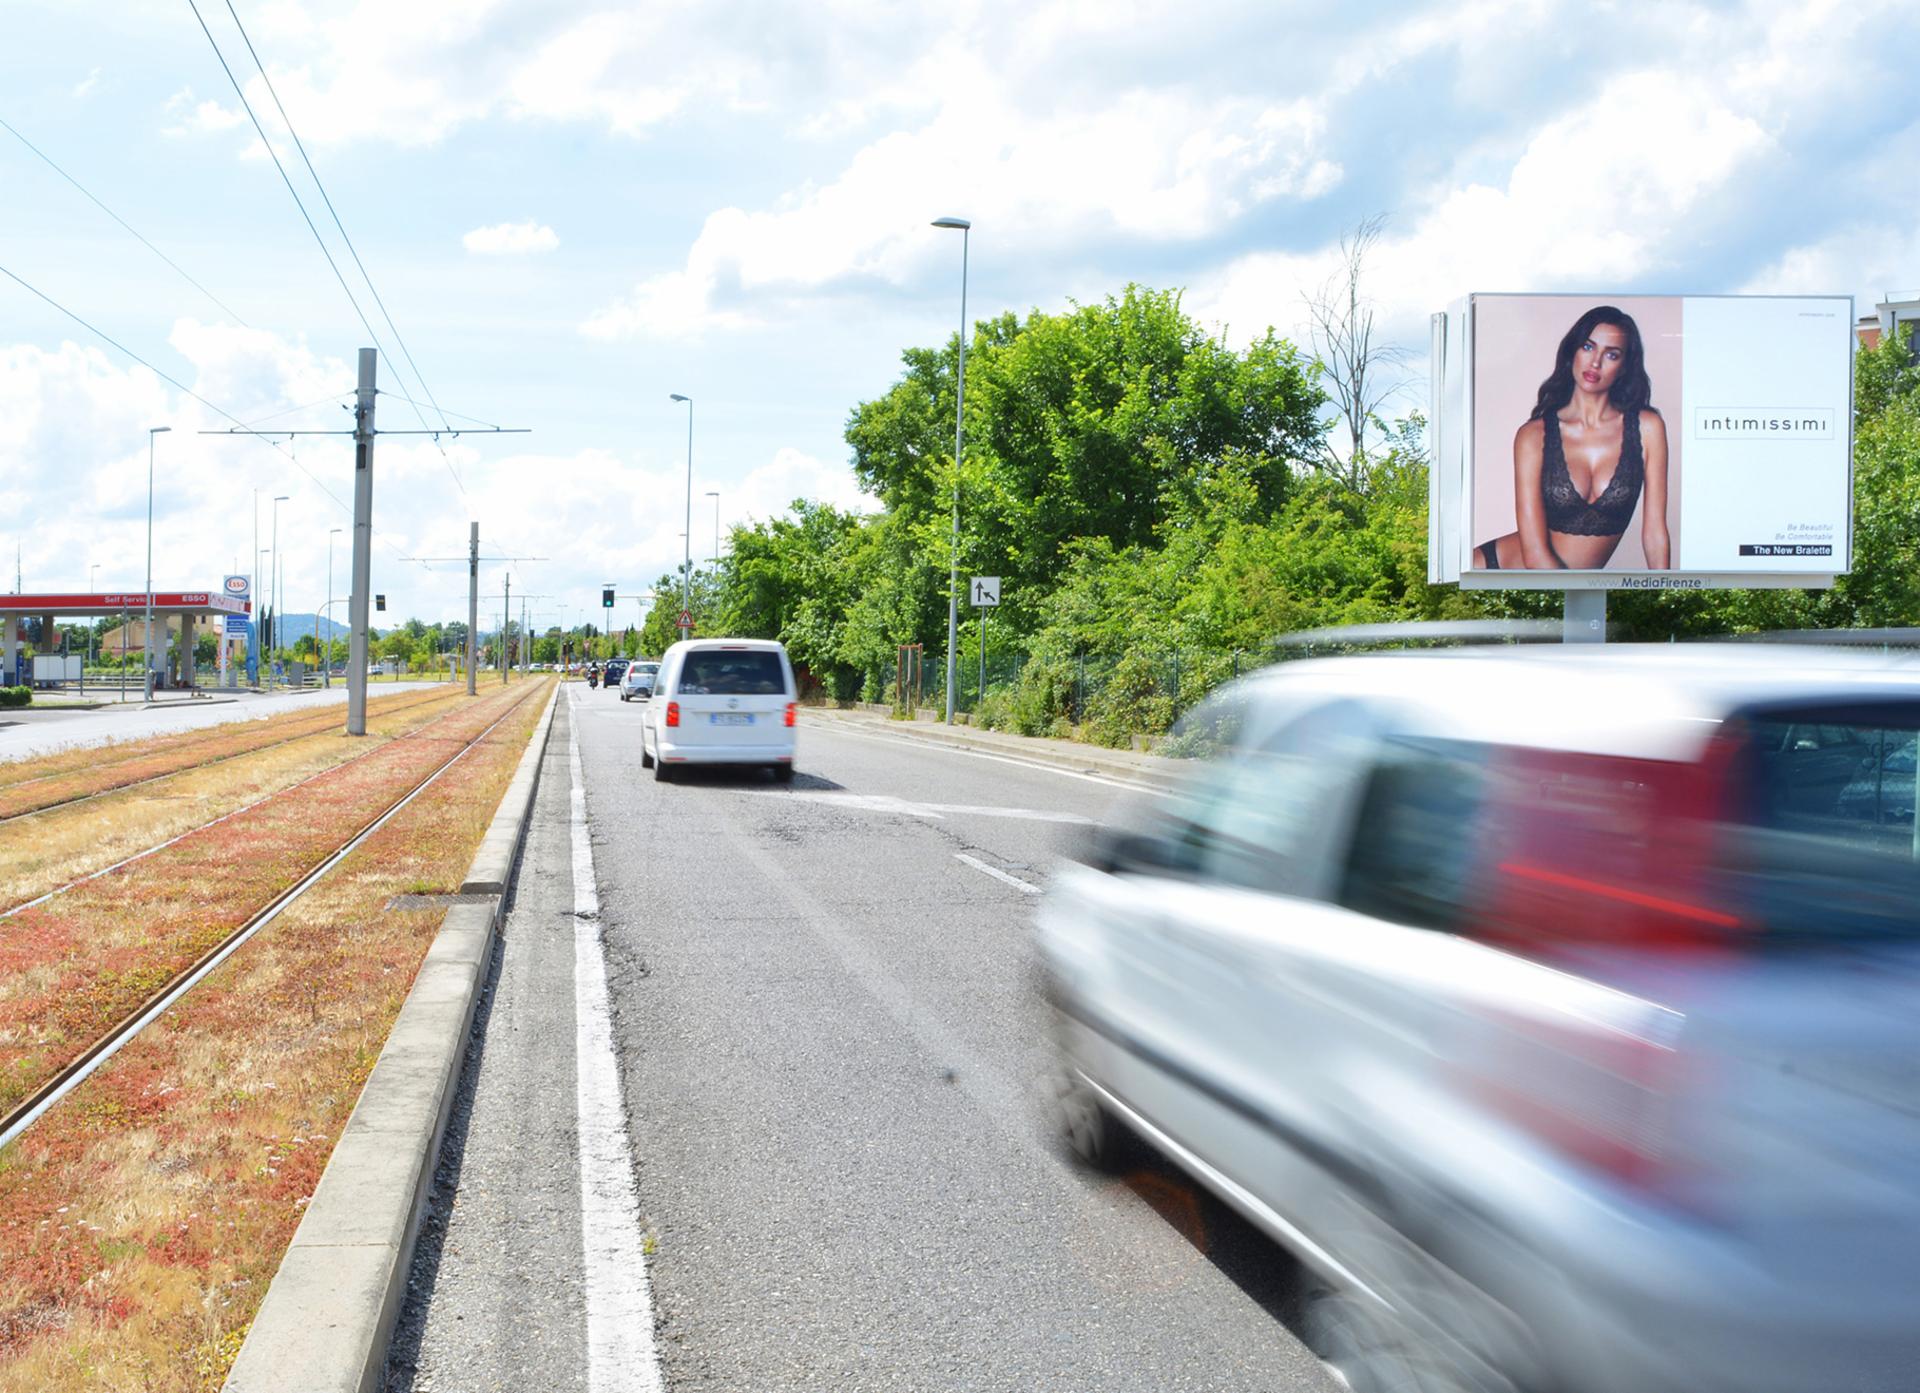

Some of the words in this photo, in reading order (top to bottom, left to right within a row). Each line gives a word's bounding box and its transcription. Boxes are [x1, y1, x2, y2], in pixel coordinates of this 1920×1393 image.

[1703, 417, 1826, 431] intimissimi
[1787, 523, 1797, 531] Be
[1799, 523, 1833, 531] Beautiful
[1775, 532, 1785, 540] Be
[1787, 532, 1833, 540] Comfortable
[1753, 546, 1771, 554] The
[1773, 546, 1793, 554] New
[1795, 546, 1831, 554] Bralette
[104, 595, 120, 603] Self
[122, 595, 147, 603] Servic
